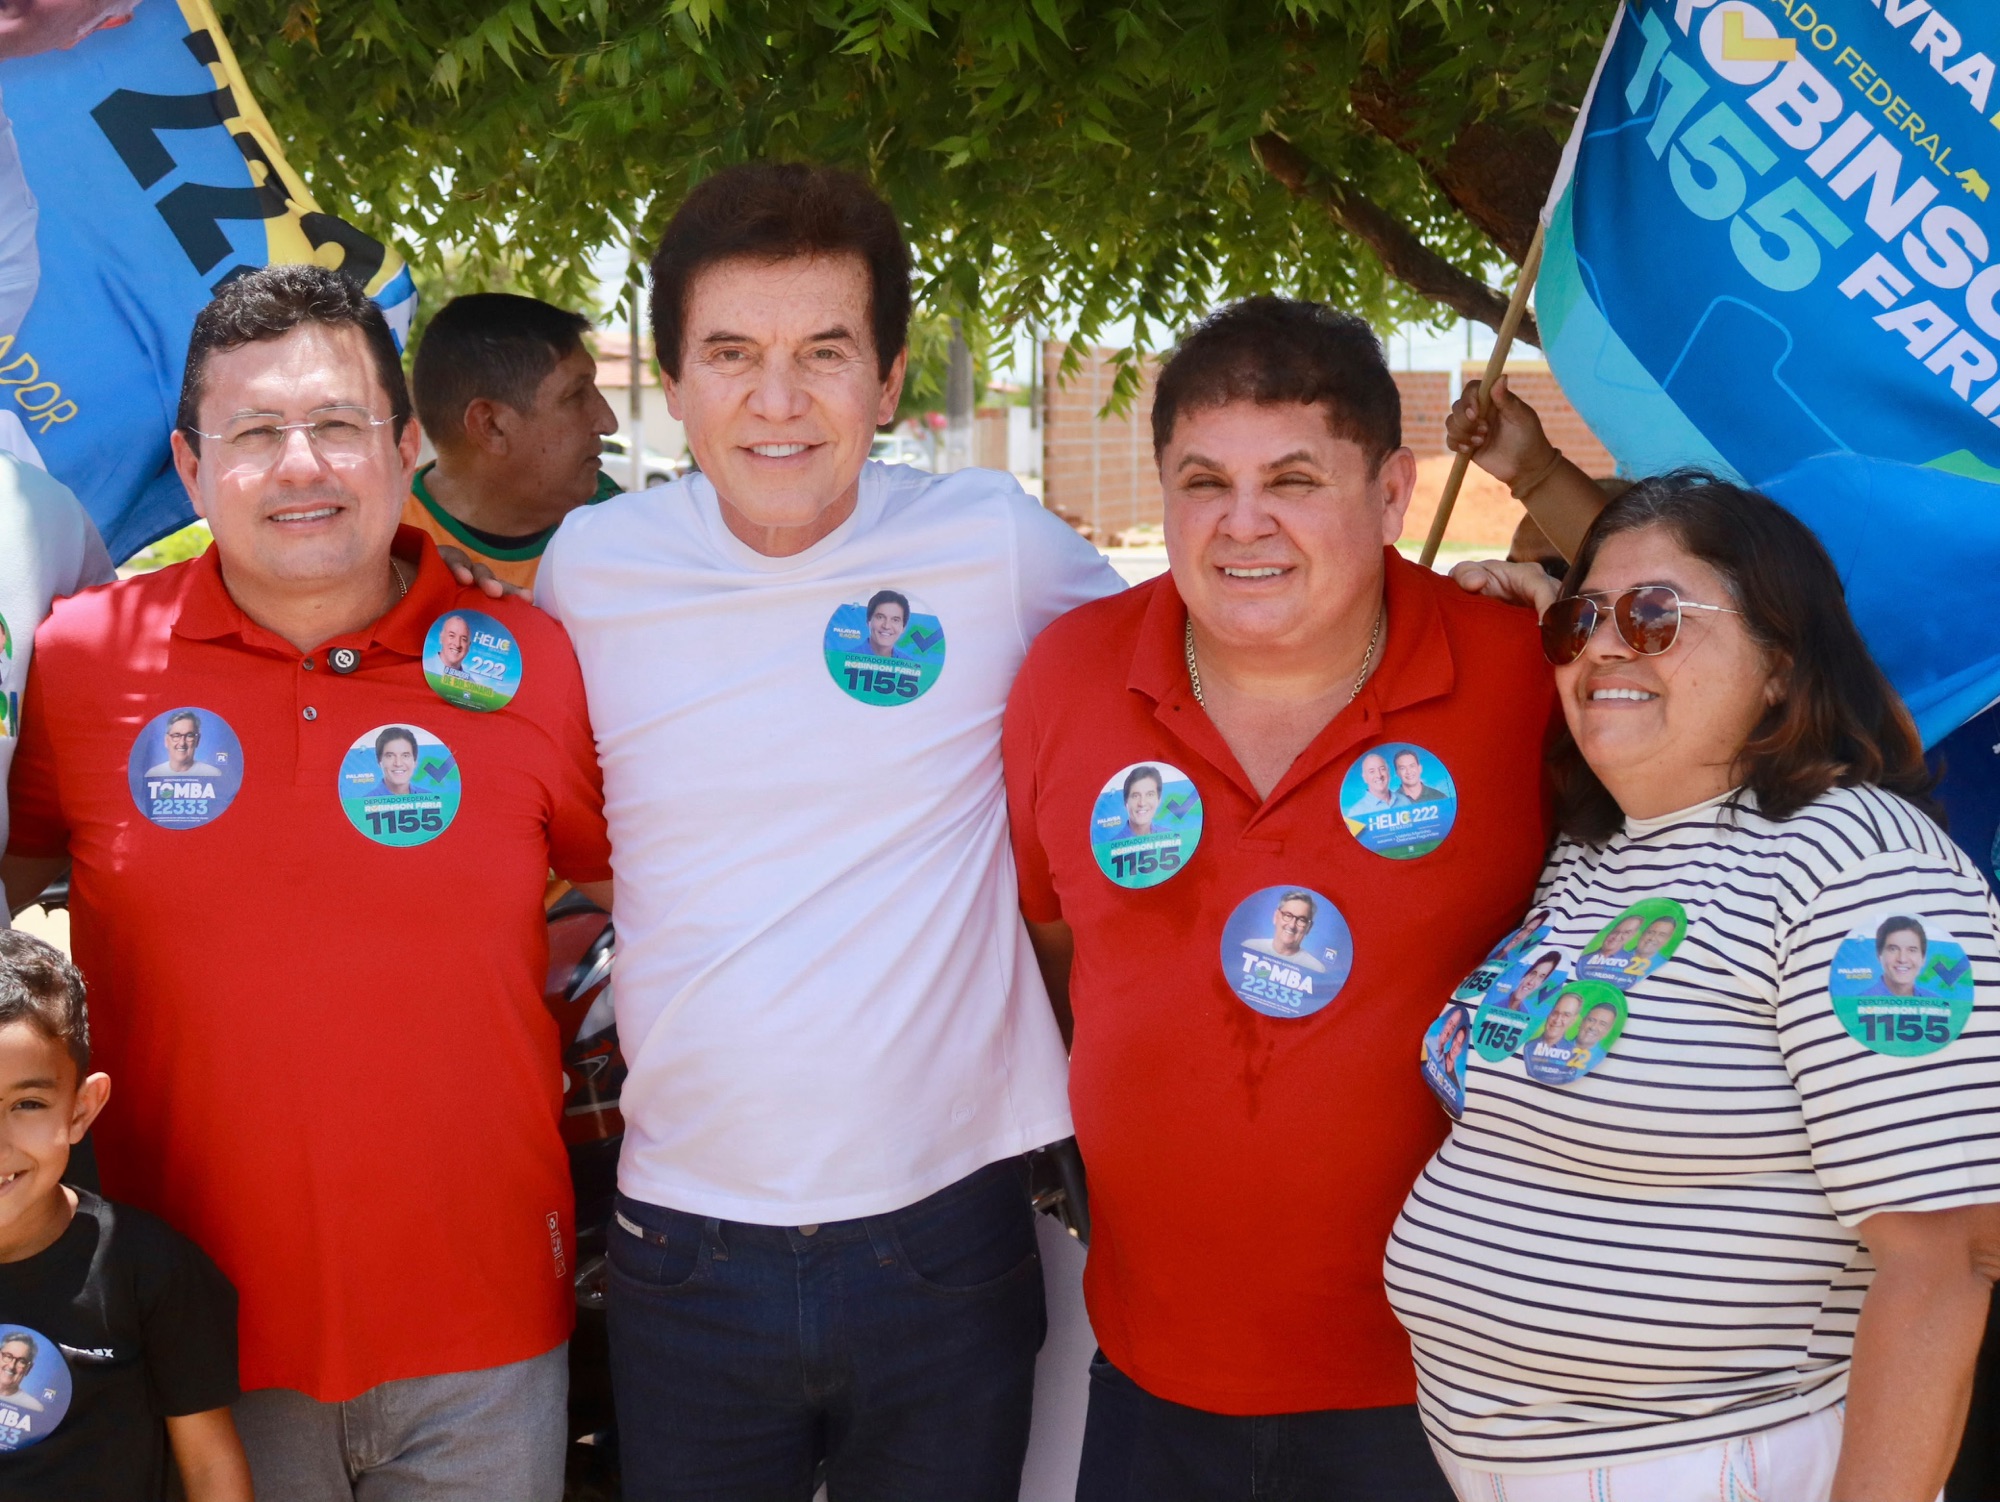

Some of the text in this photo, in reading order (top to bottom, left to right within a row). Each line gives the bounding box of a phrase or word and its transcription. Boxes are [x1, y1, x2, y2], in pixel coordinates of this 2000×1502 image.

[1870, 0, 1996, 114] VRA
[1834, 46, 1957, 176] FEDERAL
[1625, 8, 1854, 292] 1155
[1837, 252, 2000, 428] FARI
[469, 656, 506, 681] 222
[844, 661, 921, 676] ROBINSON FARIA
[845, 654, 913, 668] DEPUTADO FEDERAL
[844, 668, 919, 698] 1155
[147, 781, 216, 799] TOMBA
[363, 797, 402, 805] DEPUTADO
[152, 799, 208, 815] 22333
[364, 803, 414, 813] ROBINSON
[1412, 805, 1439, 822] 222
[365, 808, 443, 835] 1155
[1110, 838, 1143, 848] DEPUTADO
[1111, 846, 1181, 878] 1155
[1242, 952, 1313, 995] TOMBA
[1623, 956, 1651, 976] 22
[1240, 974, 1304, 1008] 22333
[1461, 970, 1499, 992] 1155
[1857, 1006, 1919, 1015] ROBINSON
[1903, 999, 1941, 1007] FEDERAL
[1477, 1020, 1523, 1052] 1155
[1858, 1015, 1950, 1043] 1155
[1566, 1047, 1592, 1069] 22
